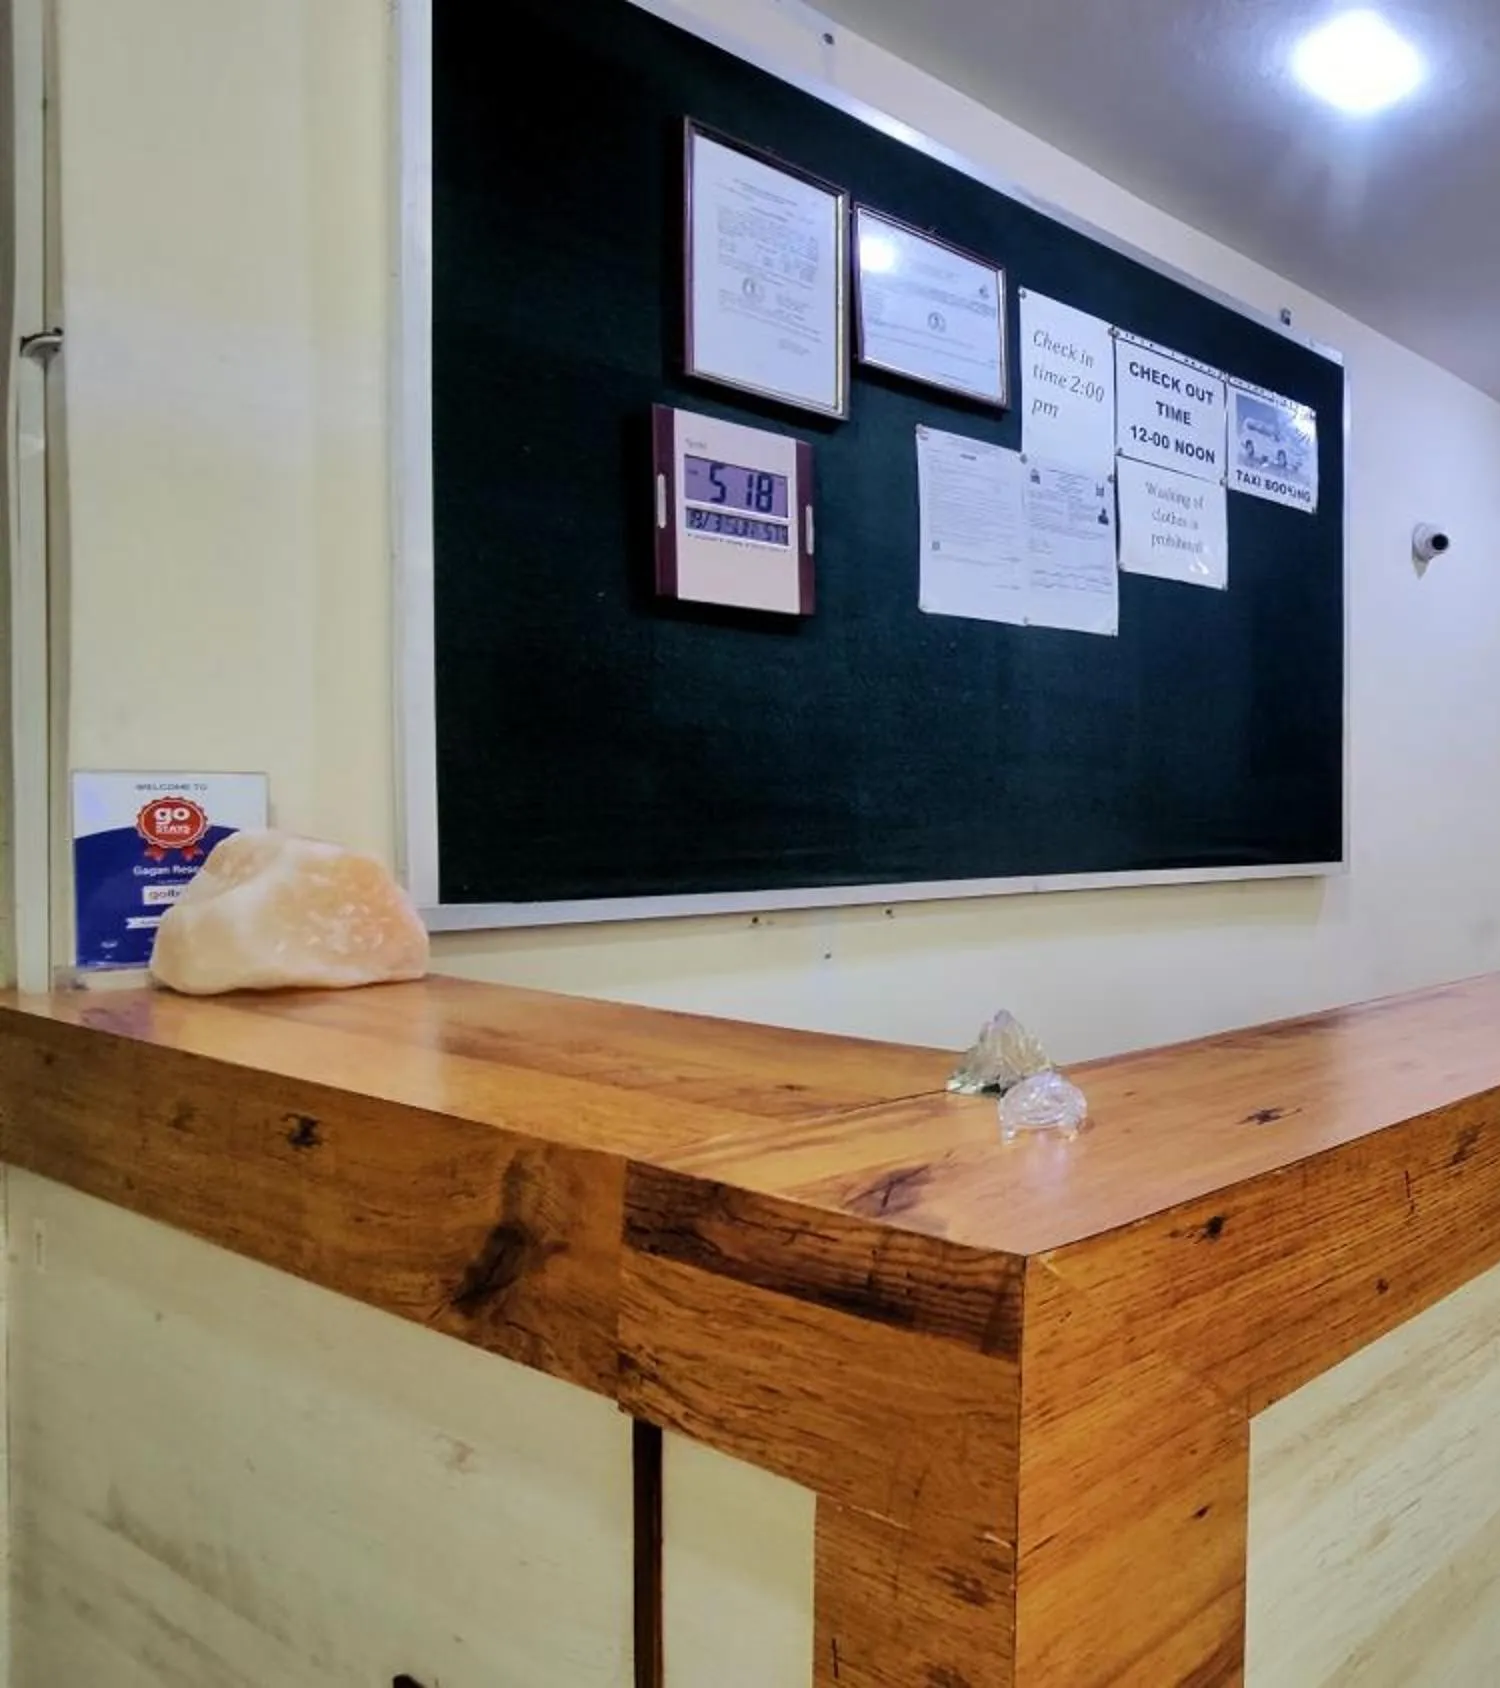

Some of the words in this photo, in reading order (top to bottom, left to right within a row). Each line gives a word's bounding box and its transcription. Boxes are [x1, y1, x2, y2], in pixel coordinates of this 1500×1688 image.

[1033, 329, 1077, 361] Check
[1080, 349, 1094, 369] in
[1033, 364, 1067, 389] time
[1069, 375, 1105, 403] 2:00
[1129, 361, 1181, 393] CHECK
[1185, 383, 1214, 405] OUT
[1031, 399, 1059, 418] pm
[1155, 400, 1192, 425] TIME
[1130, 424, 1170, 449] 12-00
[1175, 438, 1215, 464] NOON
[1145, 481, 1191, 511] Washing
[1236, 469, 1261, 487] TAXI
[1265, 478, 1312, 503] BOOKING
[136, 783, 190, 791] WELCOME
[195, 783, 208, 791] TO
[154, 807, 191, 825] go
[133, 865, 169, 877] Gagan
